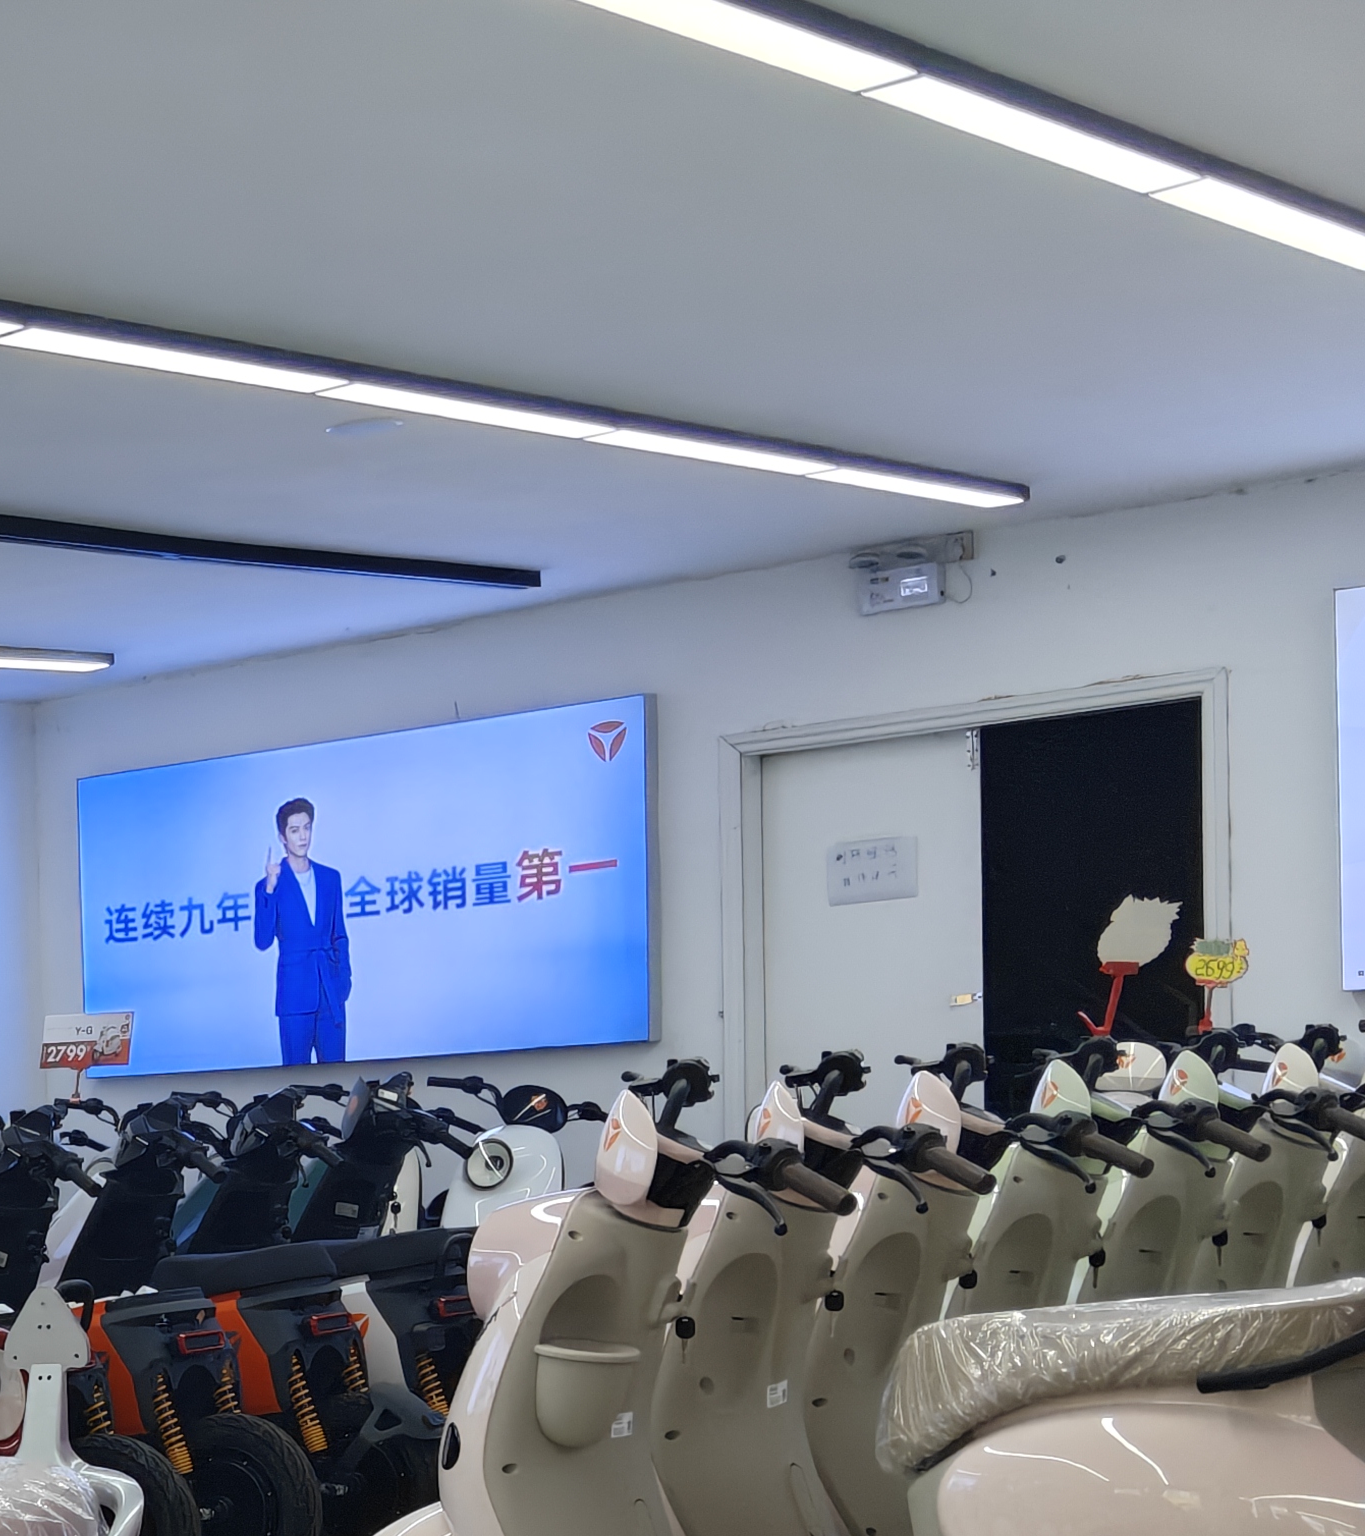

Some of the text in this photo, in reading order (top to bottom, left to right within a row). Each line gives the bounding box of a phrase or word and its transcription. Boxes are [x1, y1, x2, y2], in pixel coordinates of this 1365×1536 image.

[104, 848, 618, 945] 连续九年 全球销量第一
[1195, 958, 1235, 981] 2699
[46, 1043, 87, 1063] 2799
